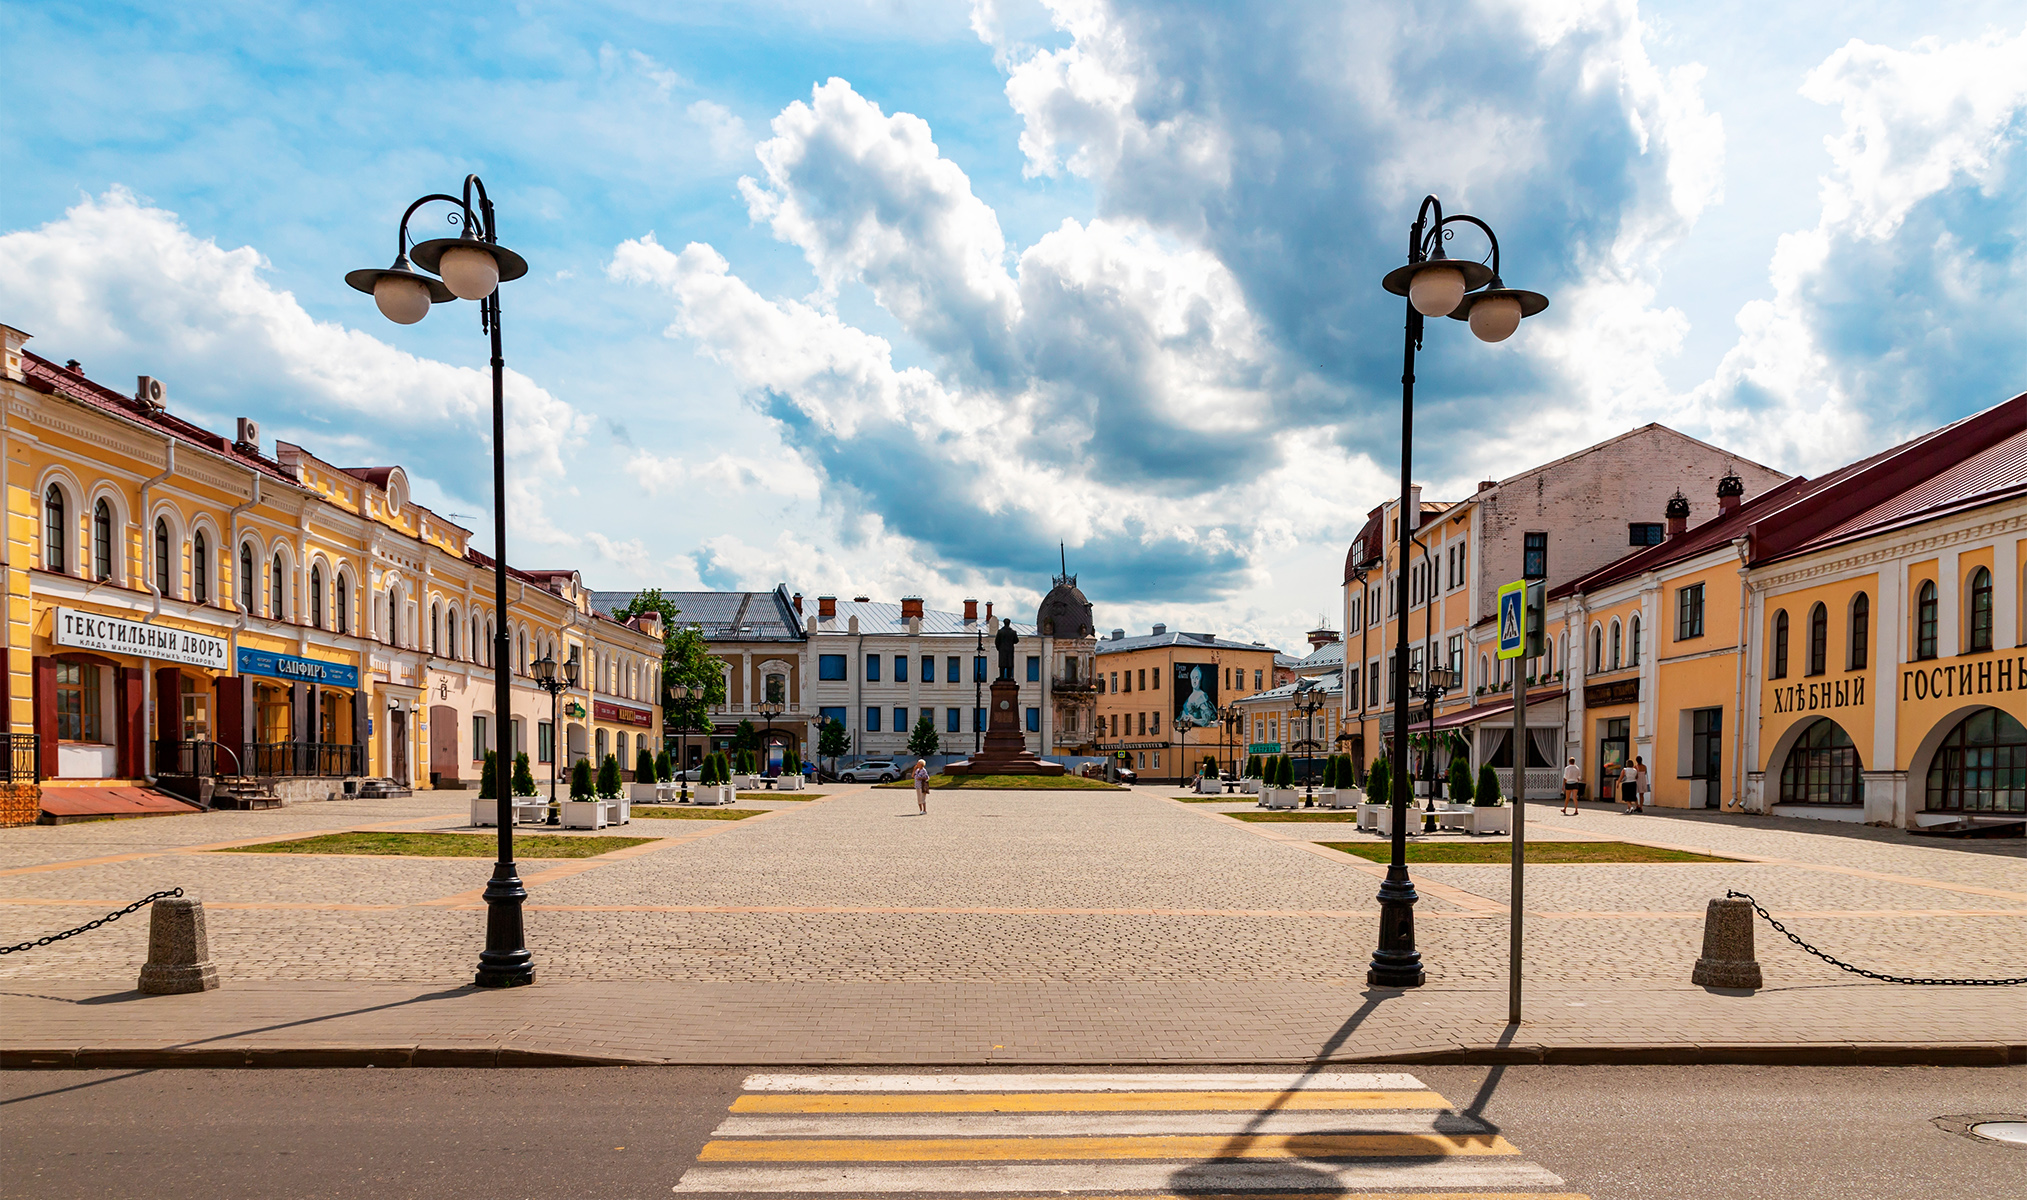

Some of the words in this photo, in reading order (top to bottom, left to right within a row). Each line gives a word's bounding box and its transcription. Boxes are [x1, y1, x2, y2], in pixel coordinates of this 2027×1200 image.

[65, 615, 177, 651] ТЕКСТИЛЬНЫЙ
[182, 635, 223, 658] ДВОРЪ
[111, 644, 180, 660] МАНУФАКТУРНЫХЪ
[278, 658, 327, 679] САПФИРЪ
[1774, 675, 1865, 713] ХЛѢБНЫЙ
